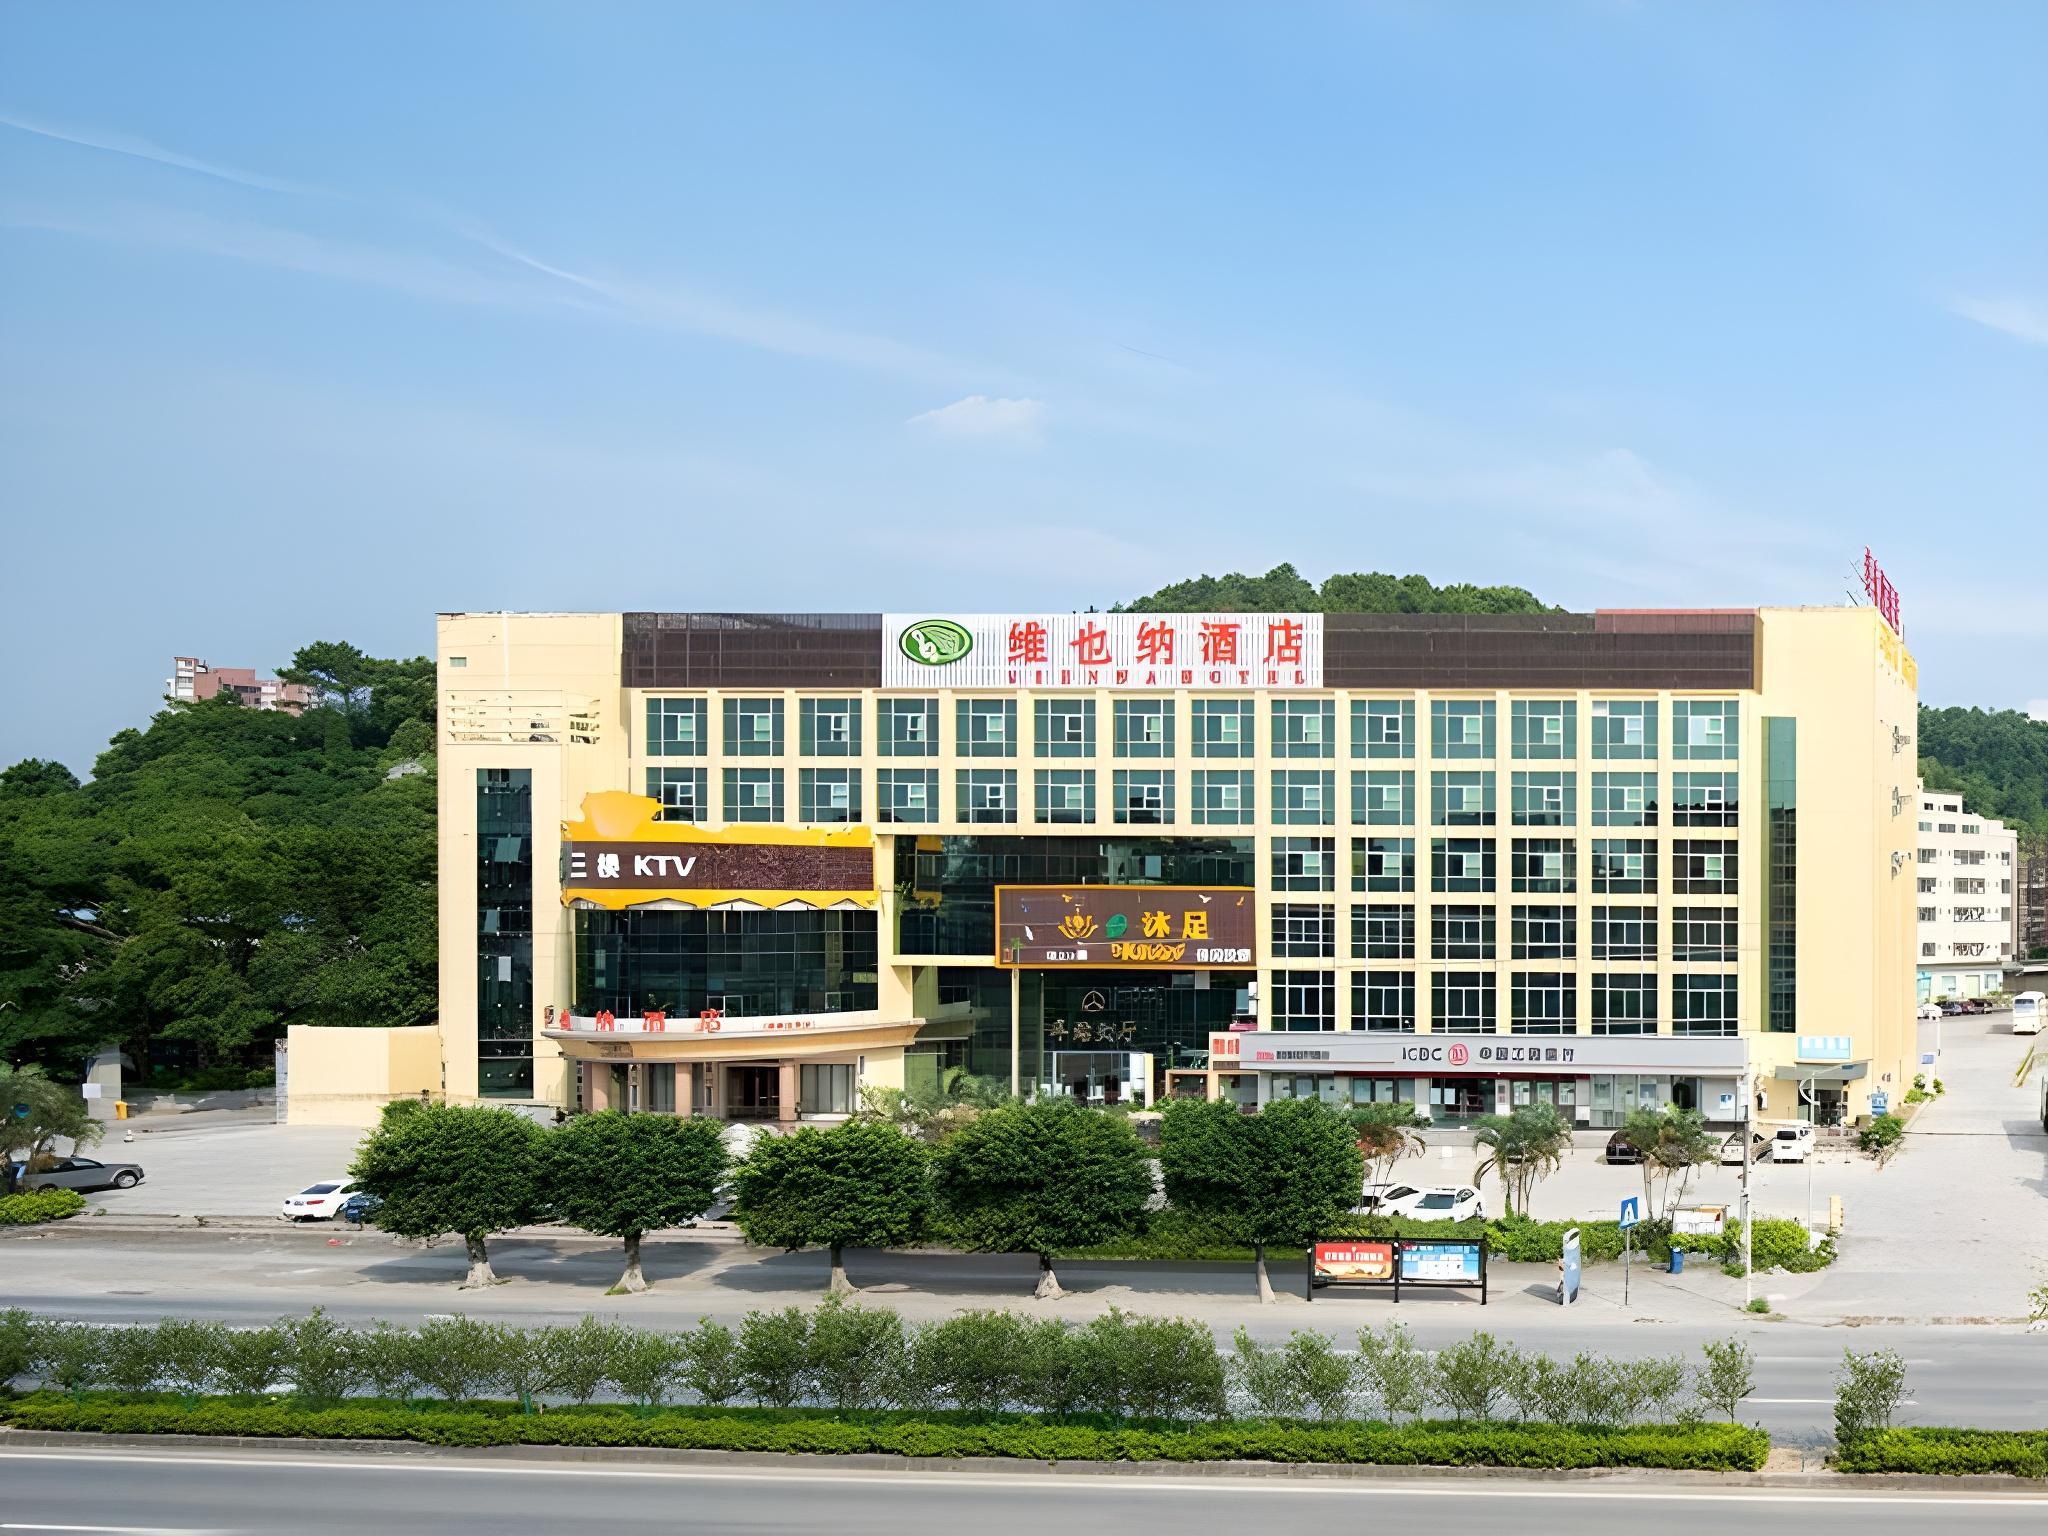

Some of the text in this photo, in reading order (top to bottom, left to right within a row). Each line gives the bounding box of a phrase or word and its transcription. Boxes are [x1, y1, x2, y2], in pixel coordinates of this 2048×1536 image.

[1008, 619, 1303, 666] 维也纳酒店
[634, 854, 697, 877] KTV
